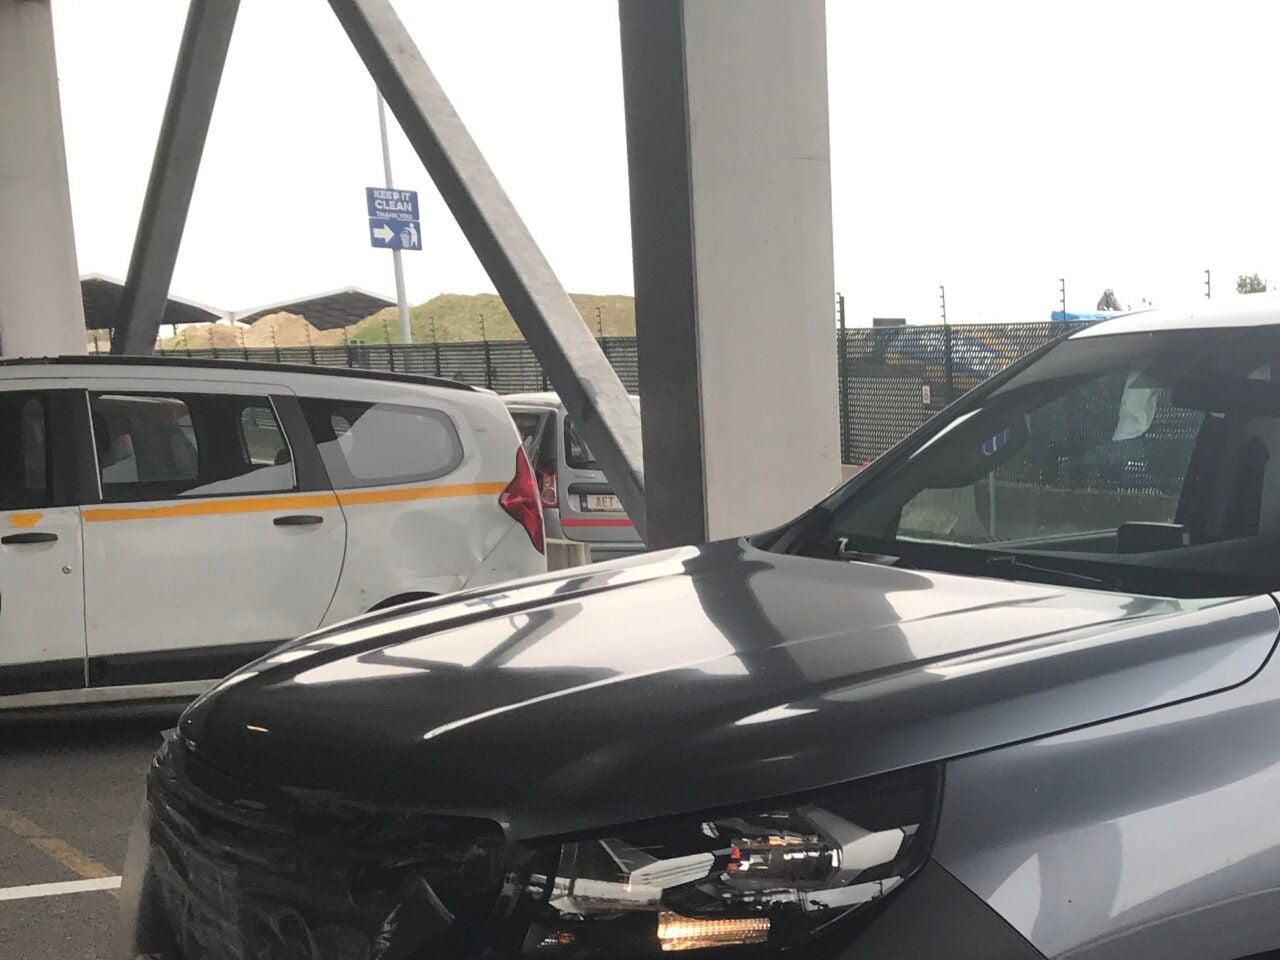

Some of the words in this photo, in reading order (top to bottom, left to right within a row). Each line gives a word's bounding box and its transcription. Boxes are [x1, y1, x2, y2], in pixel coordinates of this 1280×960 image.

[373, 190, 399, 200] KEEP
[401, 192, 411, 200] IT
[375, 200, 412, 212] CLEAN
[376, 210, 399, 218] THANK
